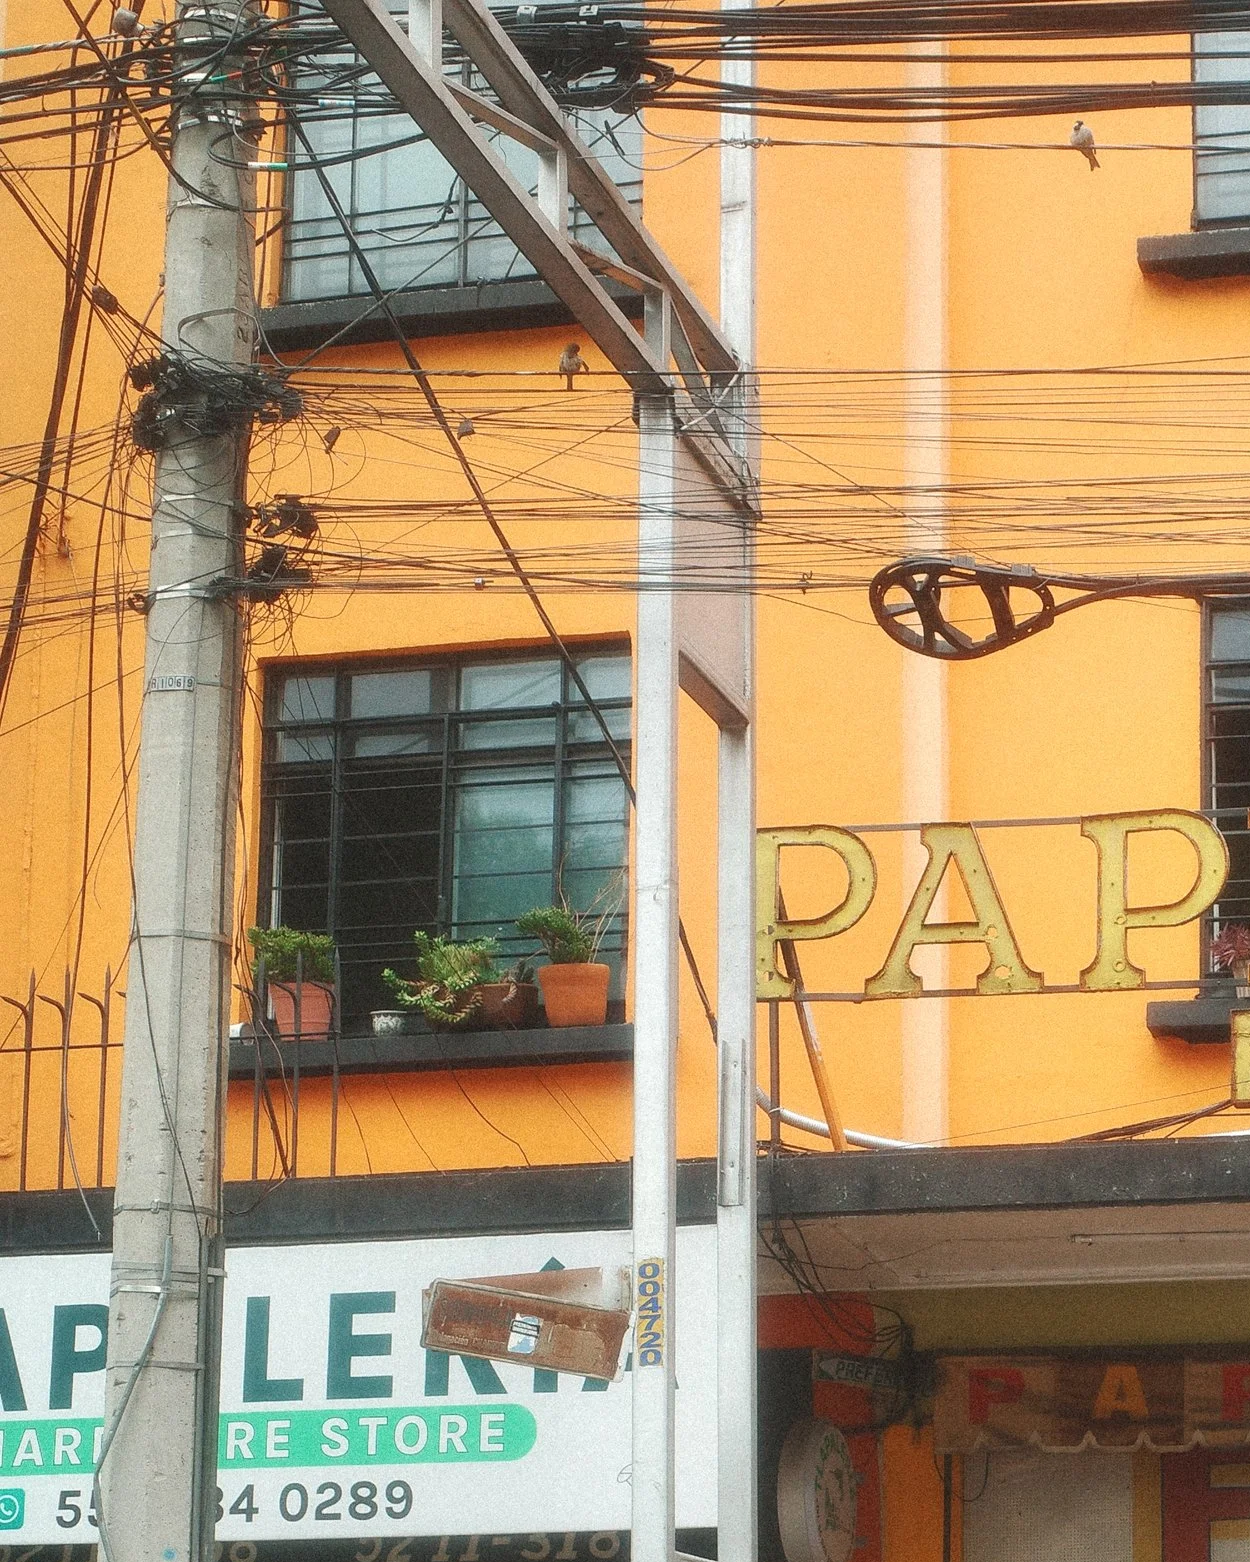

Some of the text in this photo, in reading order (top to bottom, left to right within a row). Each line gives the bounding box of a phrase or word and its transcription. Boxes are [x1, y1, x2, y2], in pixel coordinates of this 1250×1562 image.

[637, 1262, 662, 1366] 004720
[0, 1412, 505, 1467] ARRE STORE
[279, 1480, 413, 1523] 0289
